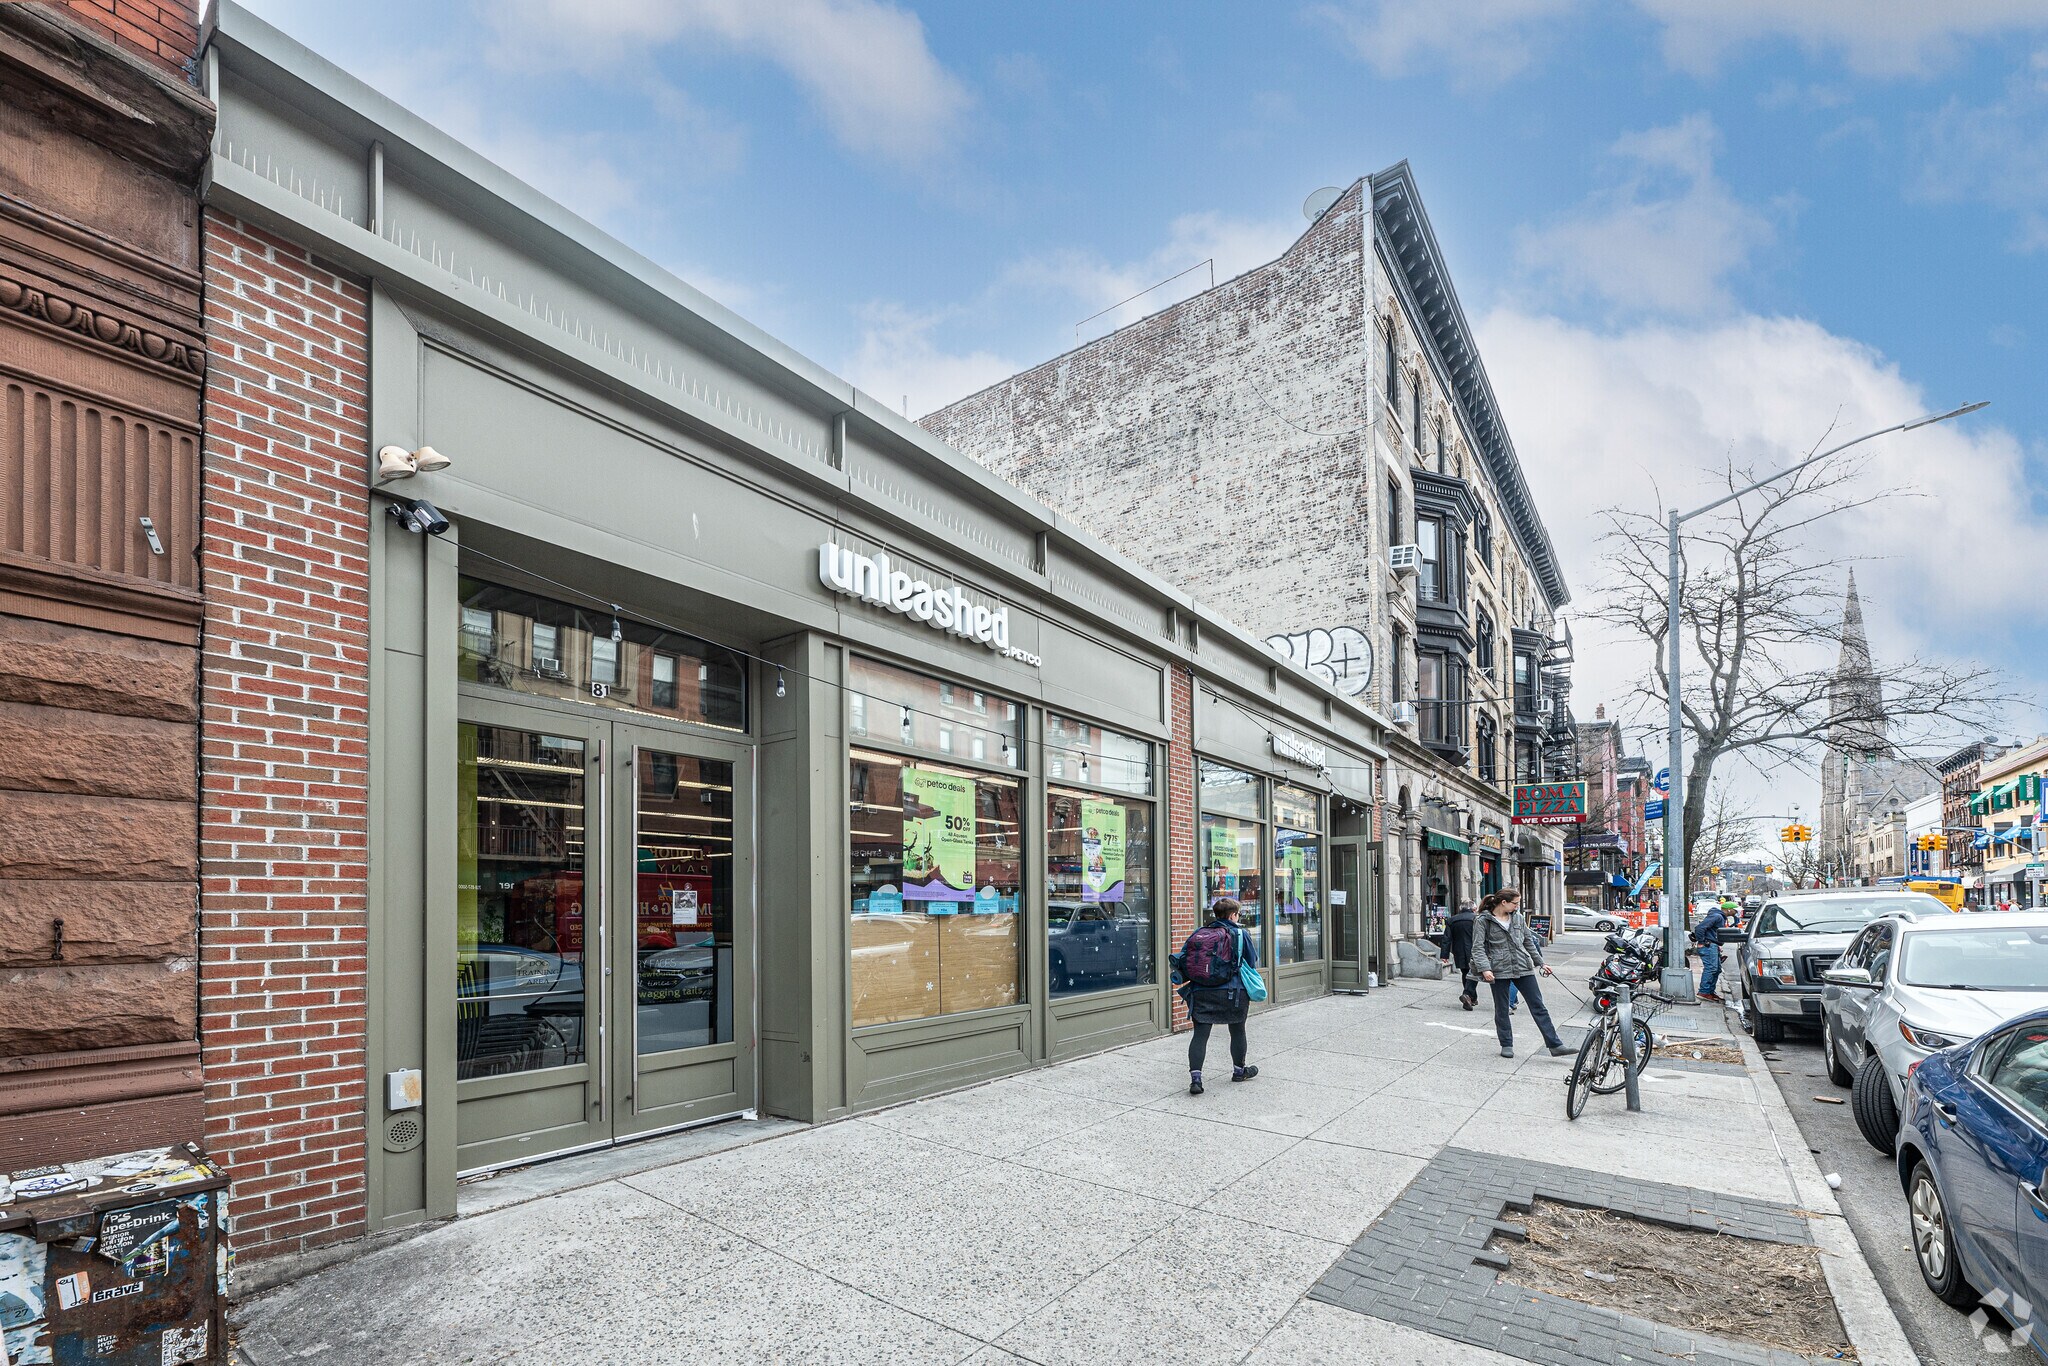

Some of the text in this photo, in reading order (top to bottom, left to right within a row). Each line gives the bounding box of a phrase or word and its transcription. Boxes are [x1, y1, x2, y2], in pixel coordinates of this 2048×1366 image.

[819, 542, 1009, 650] unleashed
[1010, 646, 1042, 667] PETCO
[593, 683, 609, 697] 81
[1273, 732, 1326, 768] unleashed
[926, 780, 966, 793] petco deals
[1517, 784, 1582, 801] ROMA
[1518, 800, 1580, 815] PIZZA
[638, 986, 703, 999] wagging tails
[15, 1309, 29, 1319] 27
